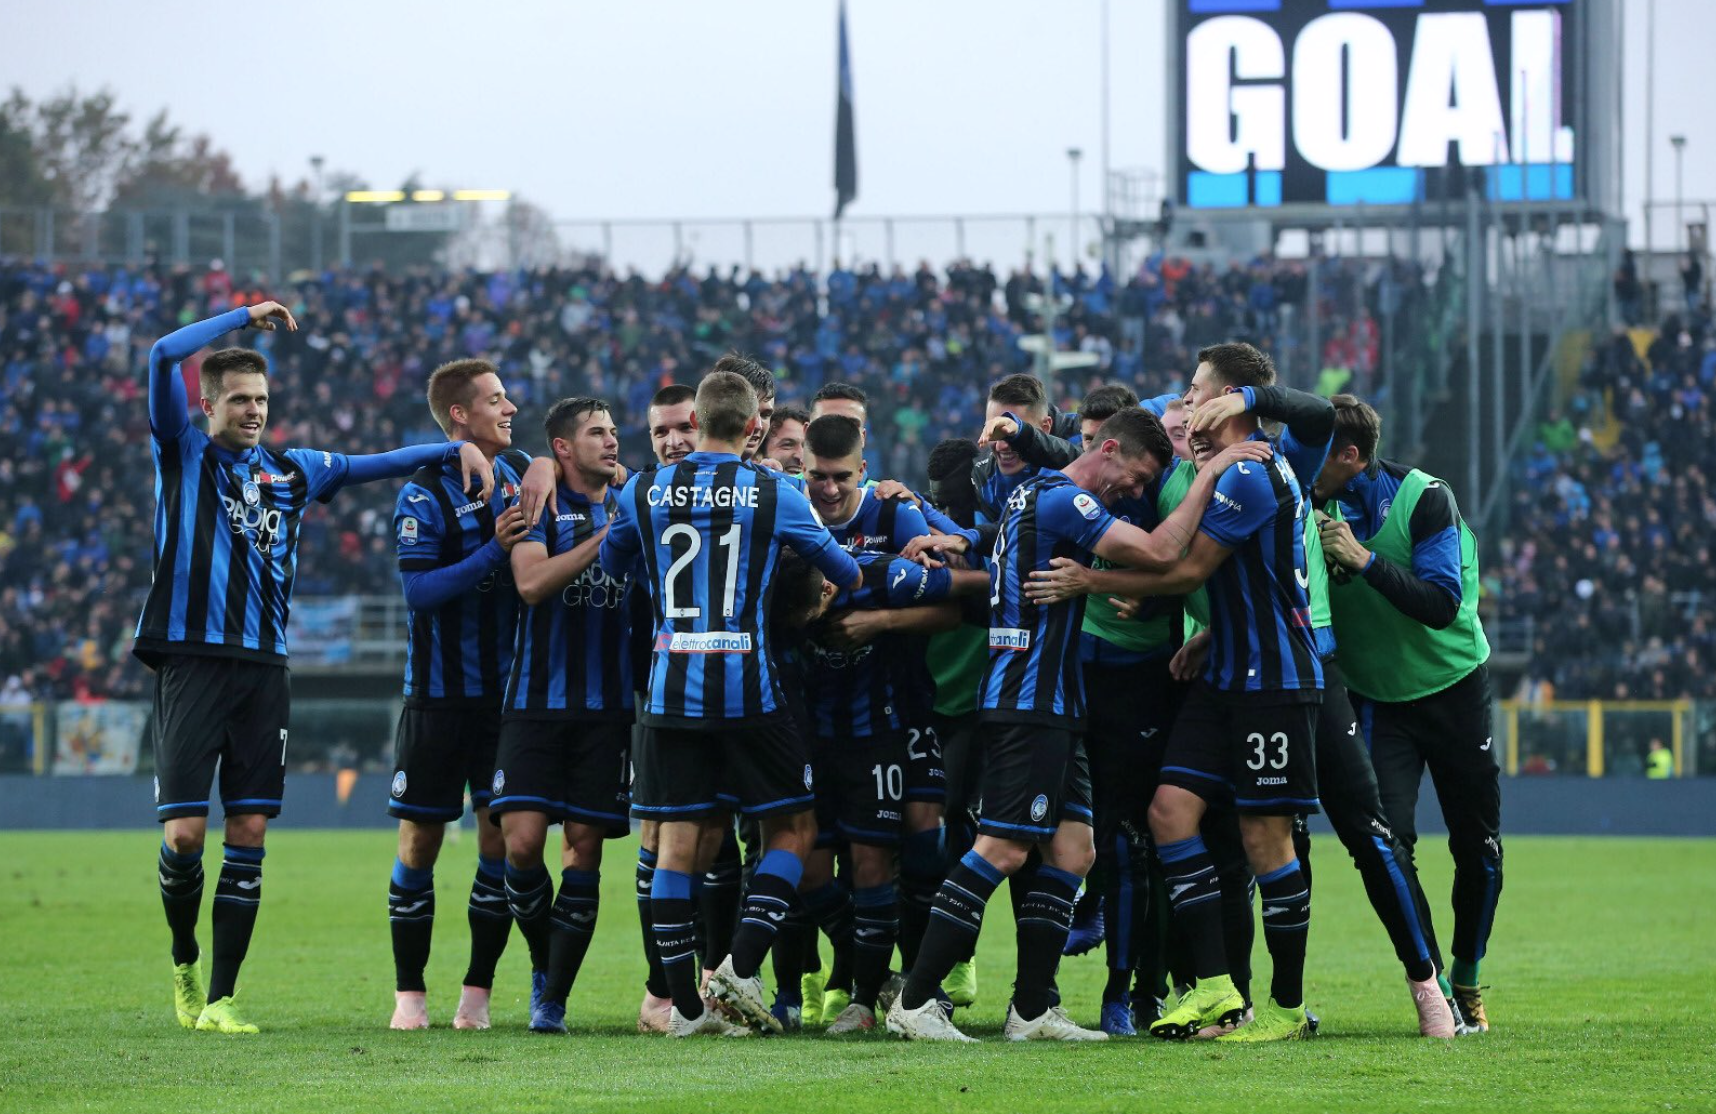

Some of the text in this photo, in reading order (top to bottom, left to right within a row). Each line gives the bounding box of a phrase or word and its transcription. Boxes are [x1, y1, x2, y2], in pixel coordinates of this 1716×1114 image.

[1187, 10, 1575, 174] GOAL
[647, 485, 760, 508] CASTAGNE
[864, 535, 888, 547] Power
[661, 523, 742, 619] 21
[562, 584, 626, 609] GROUP
[672, 635, 749, 650] elettrocanali
[280, 728, 288, 766] 7
[907, 727, 942, 760] 23
[1246, 731, 1289, 770] 33
[872, 764, 903, 801] 10
[1256, 776, 1288, 786] Joma
